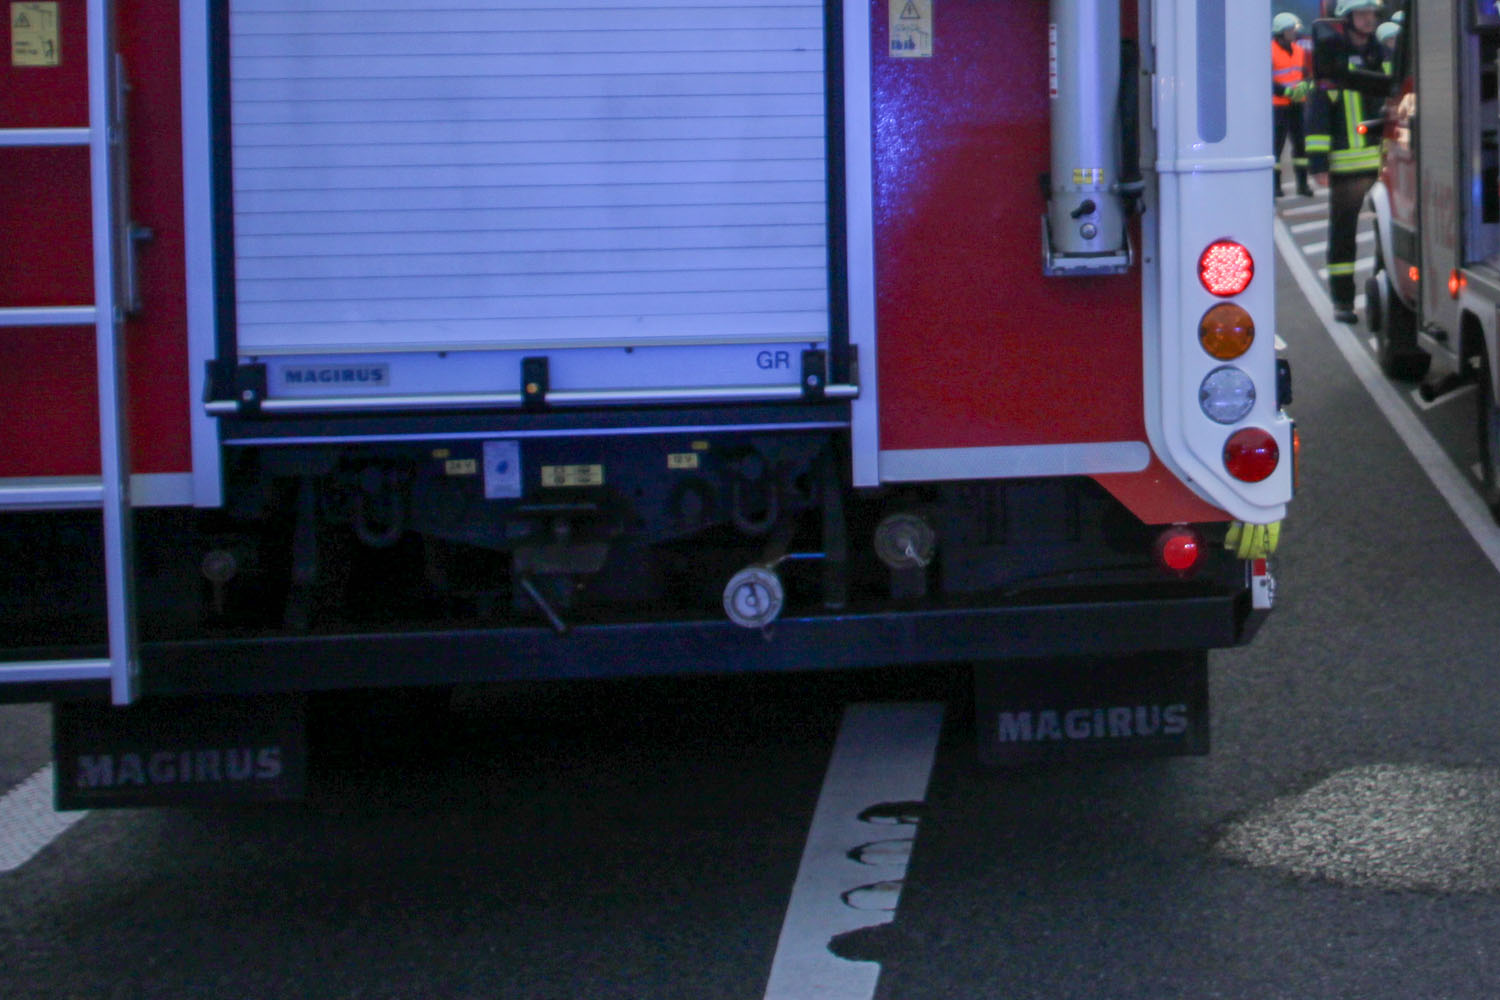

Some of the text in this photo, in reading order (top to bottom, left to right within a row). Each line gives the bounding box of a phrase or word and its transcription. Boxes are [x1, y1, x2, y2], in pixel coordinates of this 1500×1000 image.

[756, 350, 790, 370] GR
[284, 367, 383, 383] MAGIRUS
[998, 704, 1188, 742] MAGIRUS
[76, 747, 282, 787] MAGIRUS
